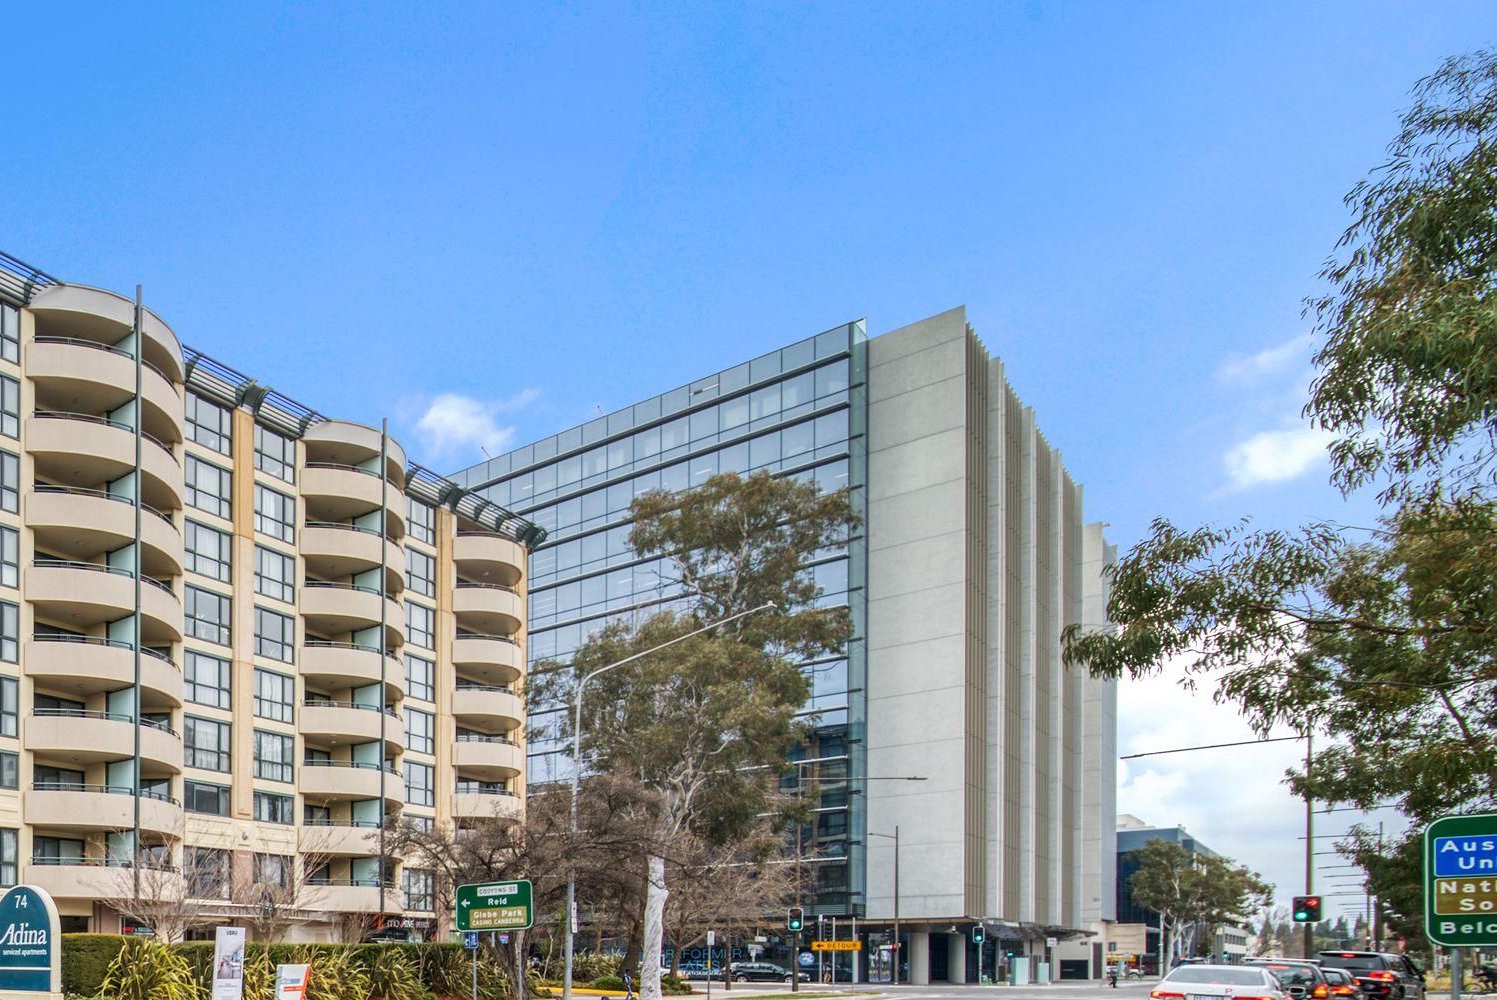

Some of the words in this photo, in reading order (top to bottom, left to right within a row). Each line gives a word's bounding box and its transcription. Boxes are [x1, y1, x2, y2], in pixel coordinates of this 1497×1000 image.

[1458, 856, 1497, 870] Un
[14, 894, 28, 909] 74
[2, 948, 21, 956] serviced
[21, 949, 47, 957] apartments
